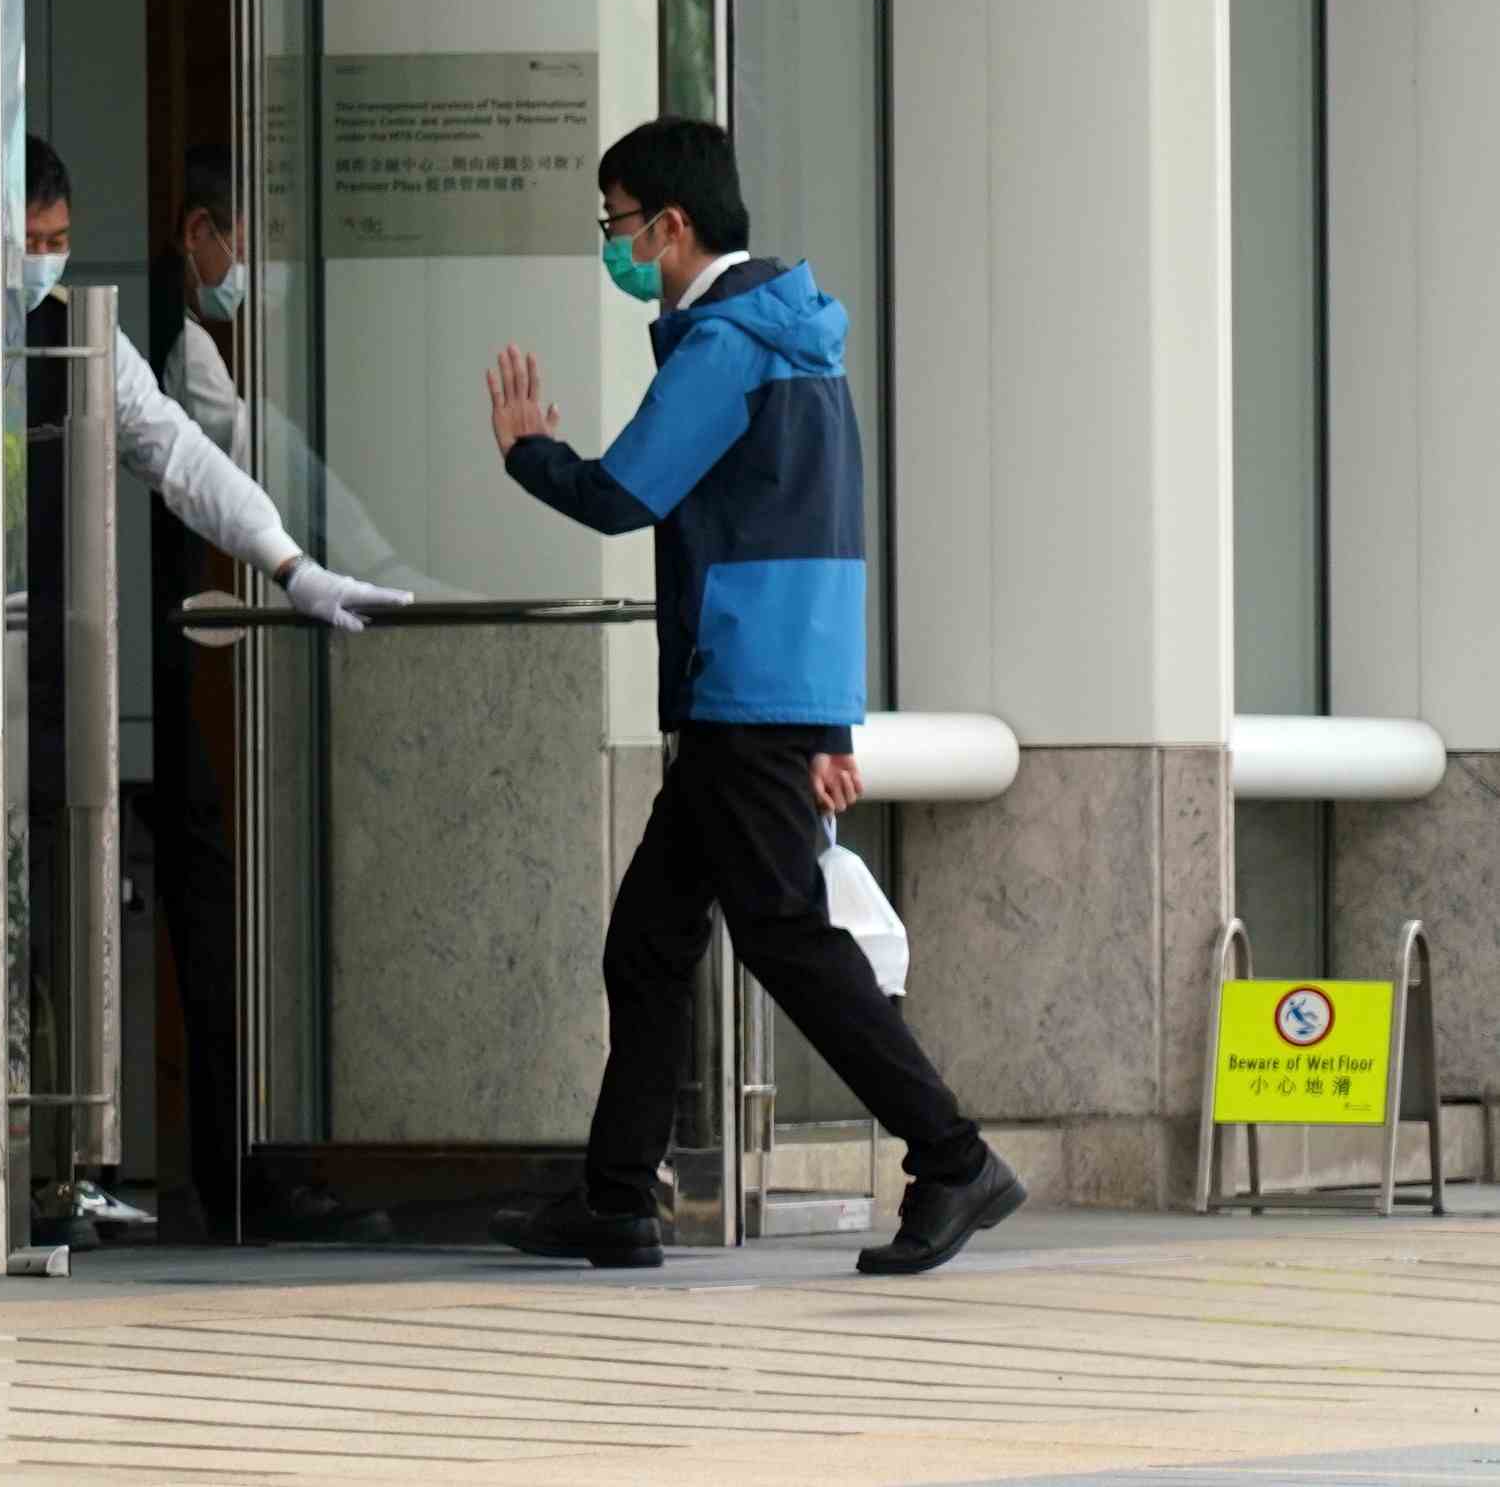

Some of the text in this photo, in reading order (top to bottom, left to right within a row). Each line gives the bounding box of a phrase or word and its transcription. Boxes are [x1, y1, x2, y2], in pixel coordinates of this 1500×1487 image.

[1228, 1053, 1375, 1072] Beware of Wet Floor
[1249, 1075, 1353, 1096] 小心地滑
